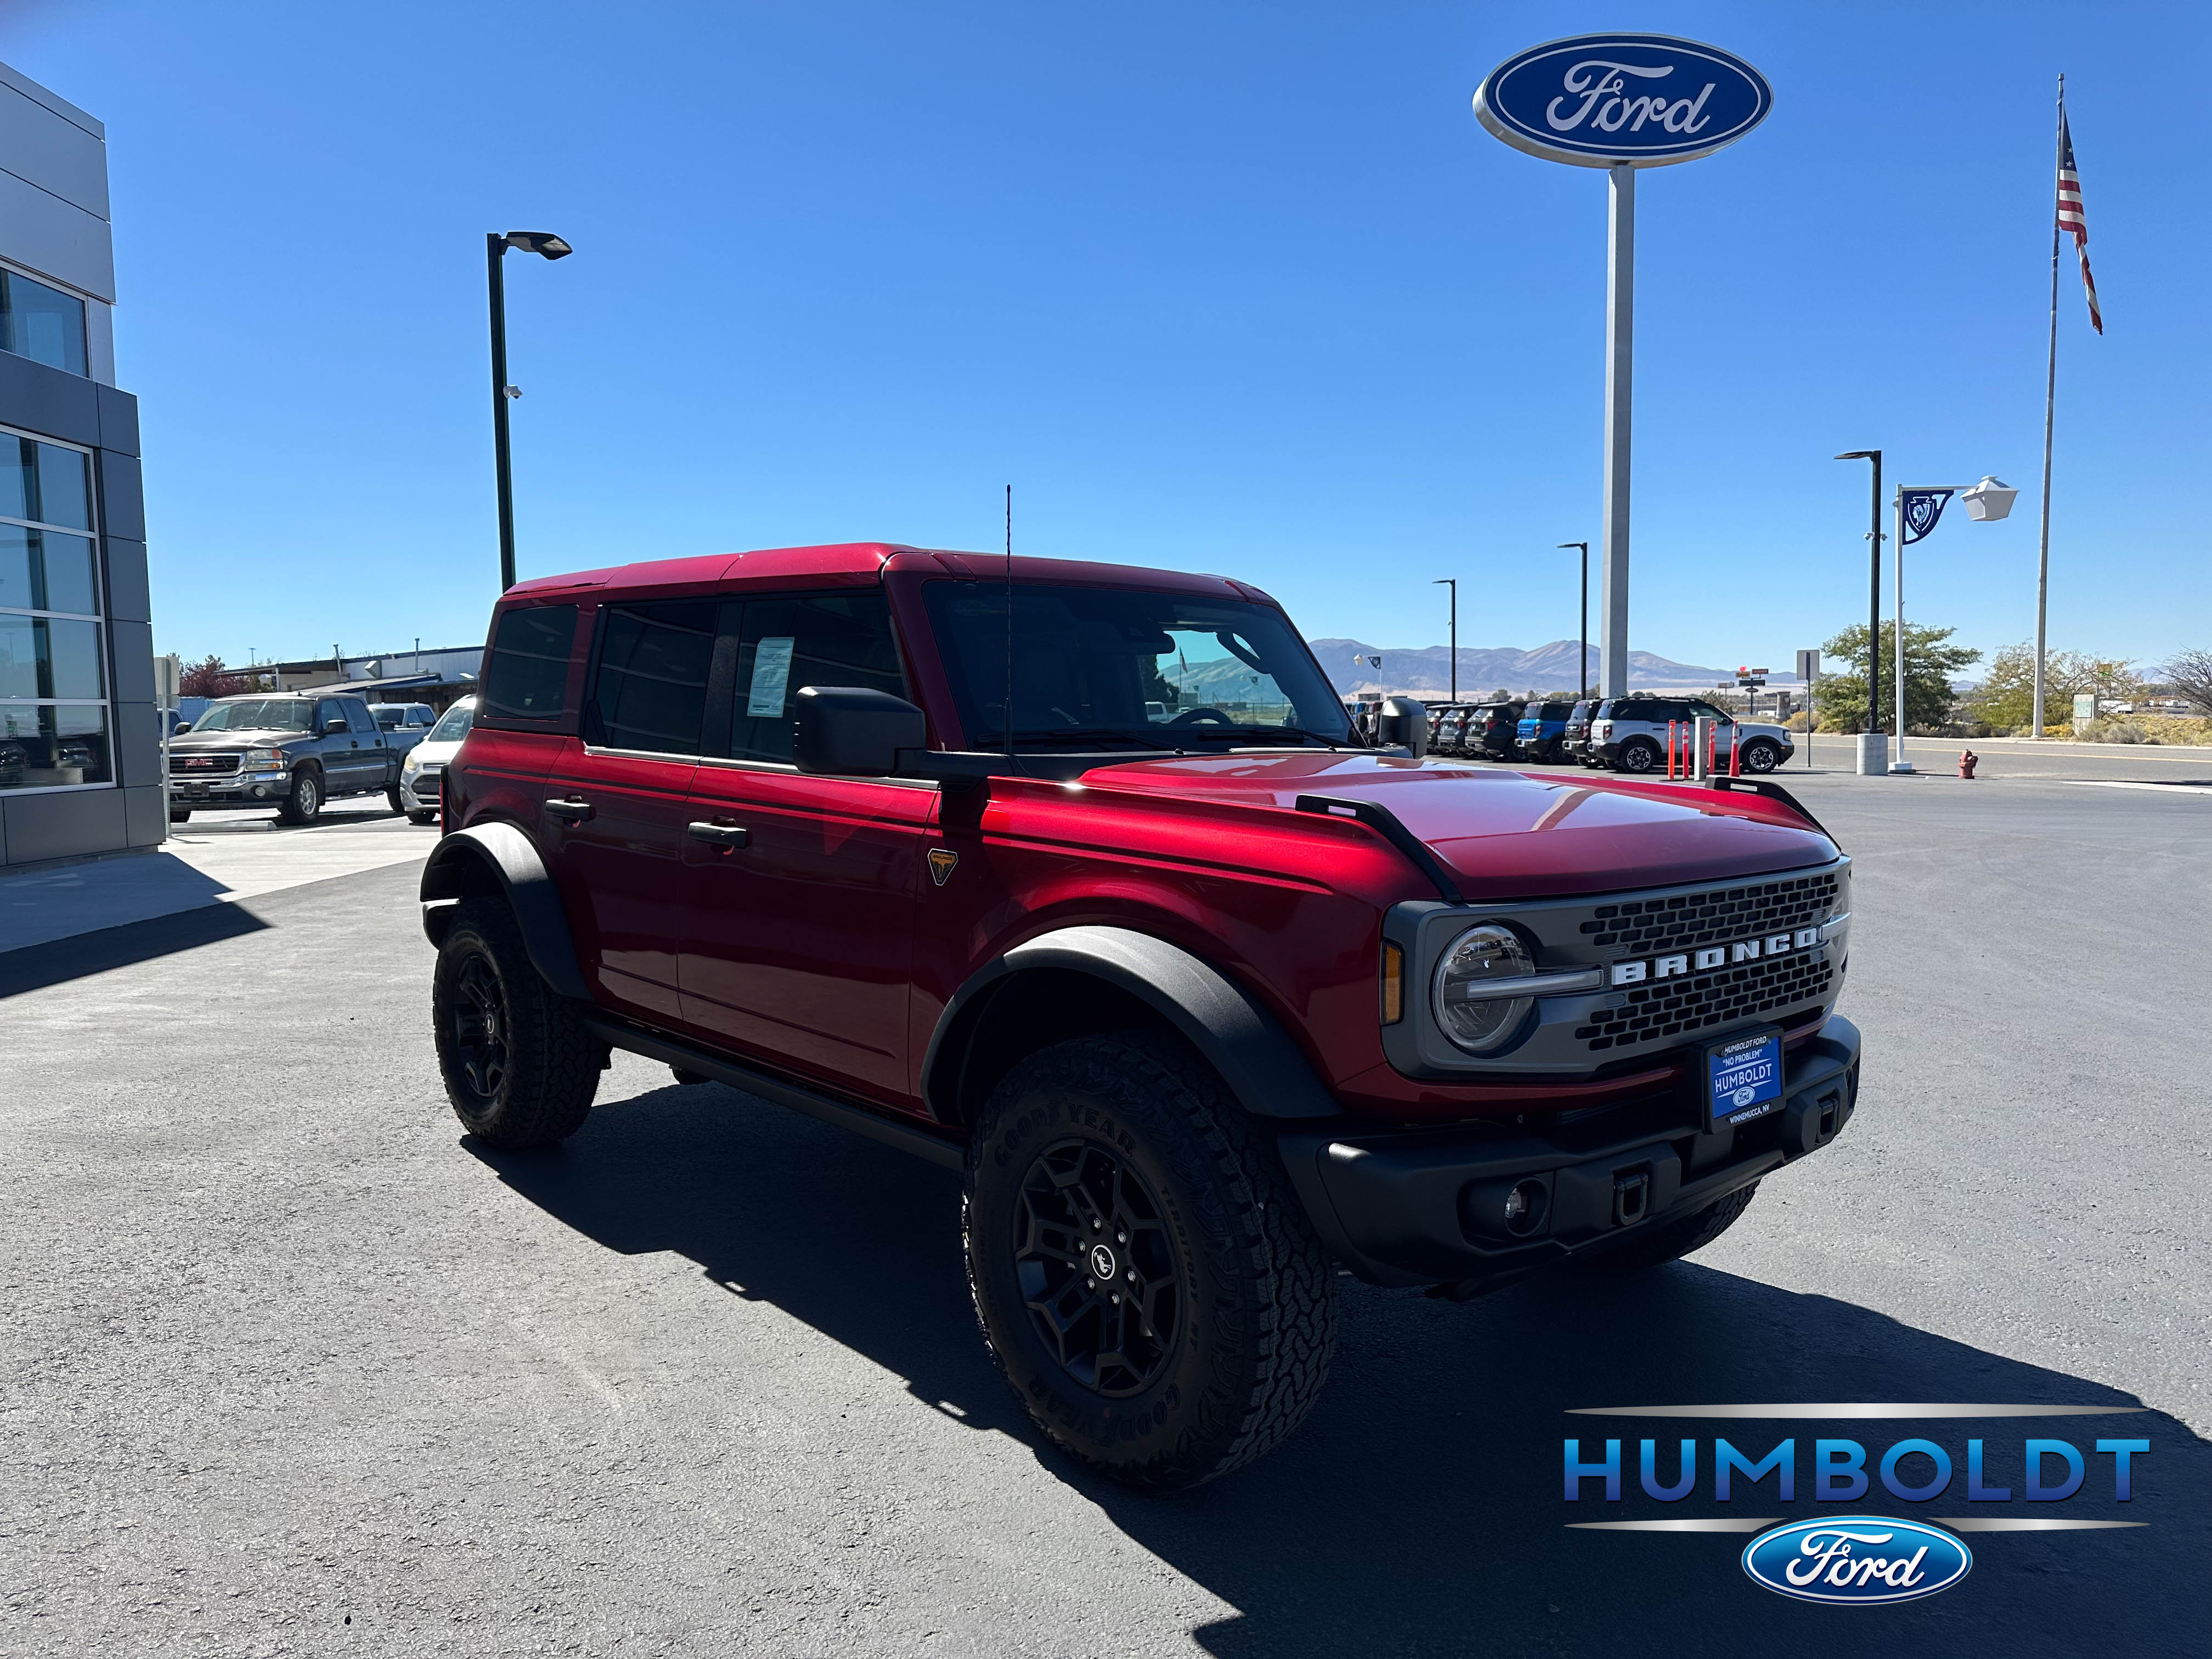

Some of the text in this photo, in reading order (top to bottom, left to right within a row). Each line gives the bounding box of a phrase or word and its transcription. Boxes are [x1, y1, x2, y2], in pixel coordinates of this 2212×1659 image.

[1546, 60, 1716, 134] Ford
[185, 758, 213, 766] GMC
[1611, 927, 1818, 985] BRONCO
[1724, 1036, 1767, 1054] HUMBOLDT FORD
[1715, 1063, 1772, 1093] HUMBOLDT
[1737, 1090, 1750, 1103] Ford
[1729, 1103, 1770, 1124] WINNEMUCCA, NV
[994, 1099, 1137, 1167] GOODYEAR
[1160, 1185, 1199, 1304] TERRITORY
